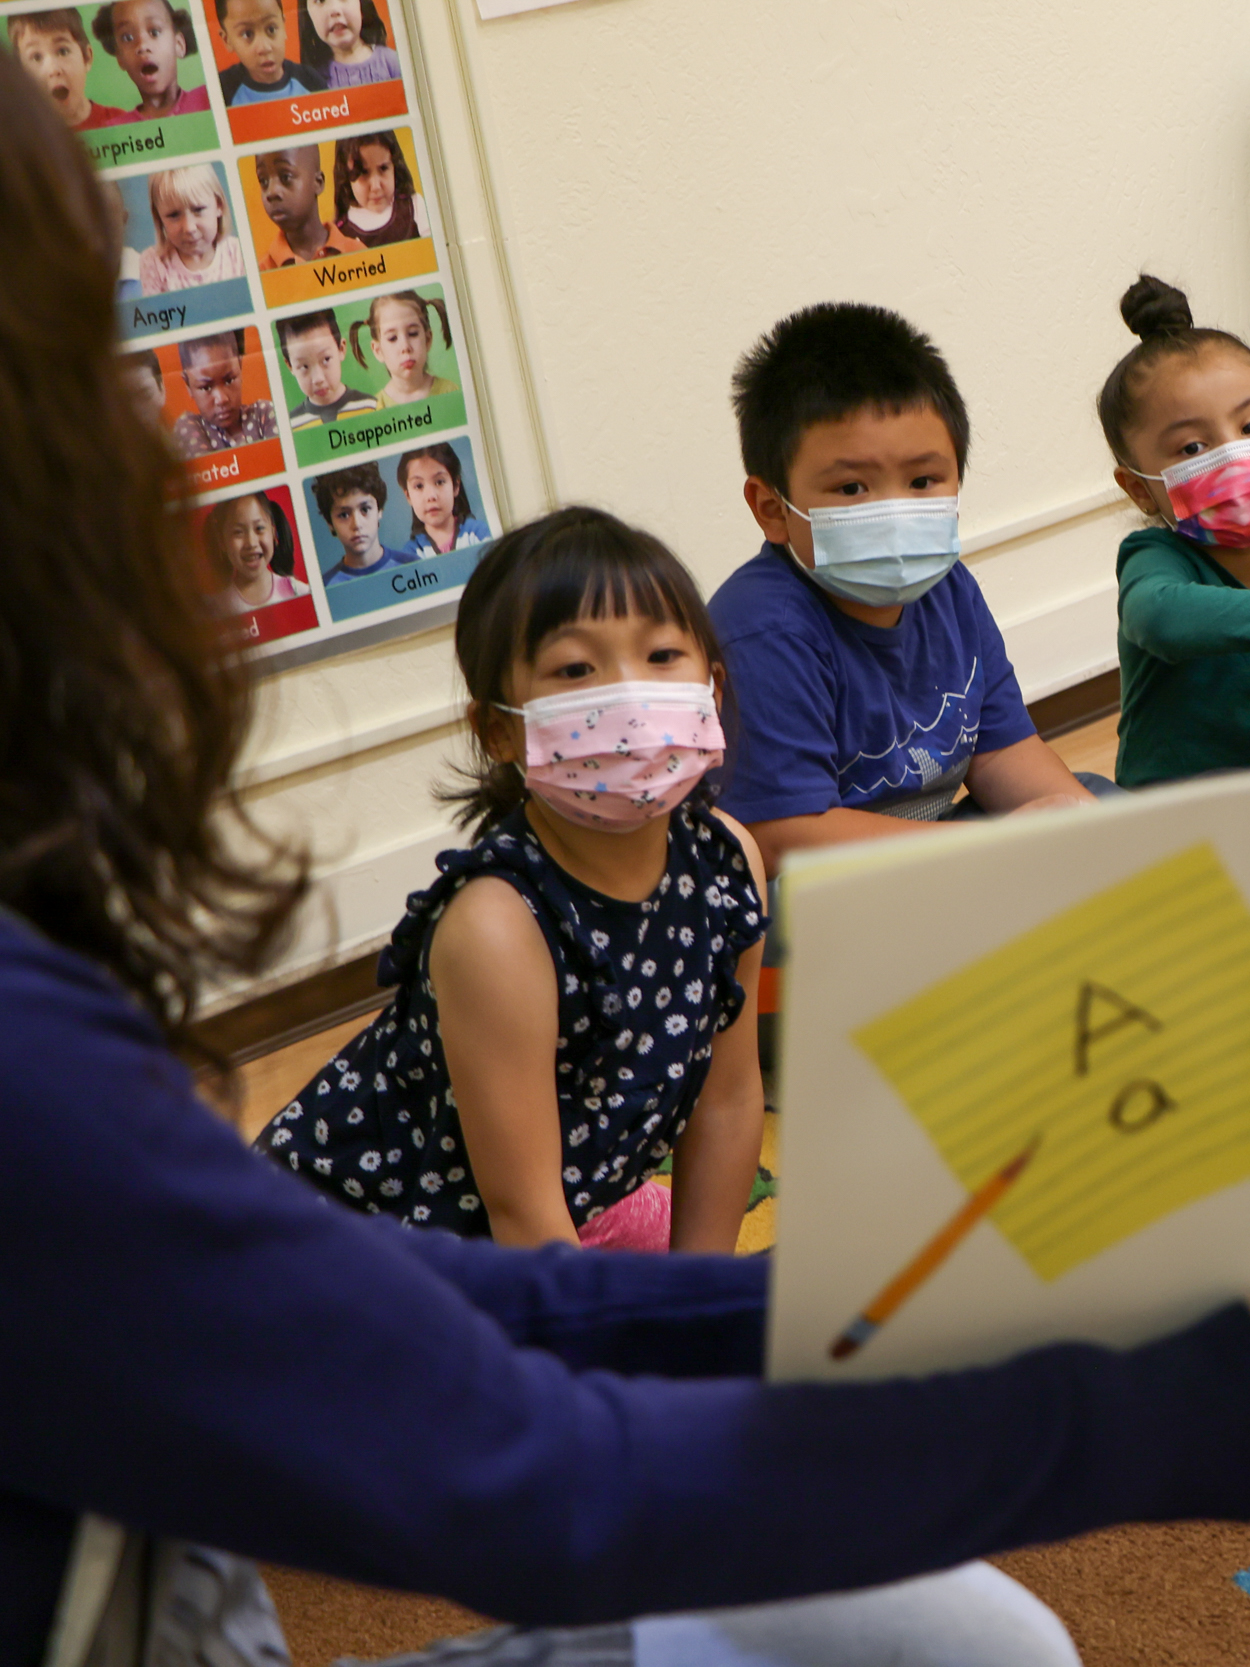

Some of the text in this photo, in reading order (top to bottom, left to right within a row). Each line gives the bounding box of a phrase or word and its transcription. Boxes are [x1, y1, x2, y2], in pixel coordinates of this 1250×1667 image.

[290, 95, 350, 125] Scared
[88, 126, 165, 165] urprised
[313, 254, 386, 288] Worried
[133, 305, 187, 330] Angry
[328, 406, 432, 450] Disappointed
[391, 569, 438, 595] Calm
[1074, 979, 1165, 1078] A
